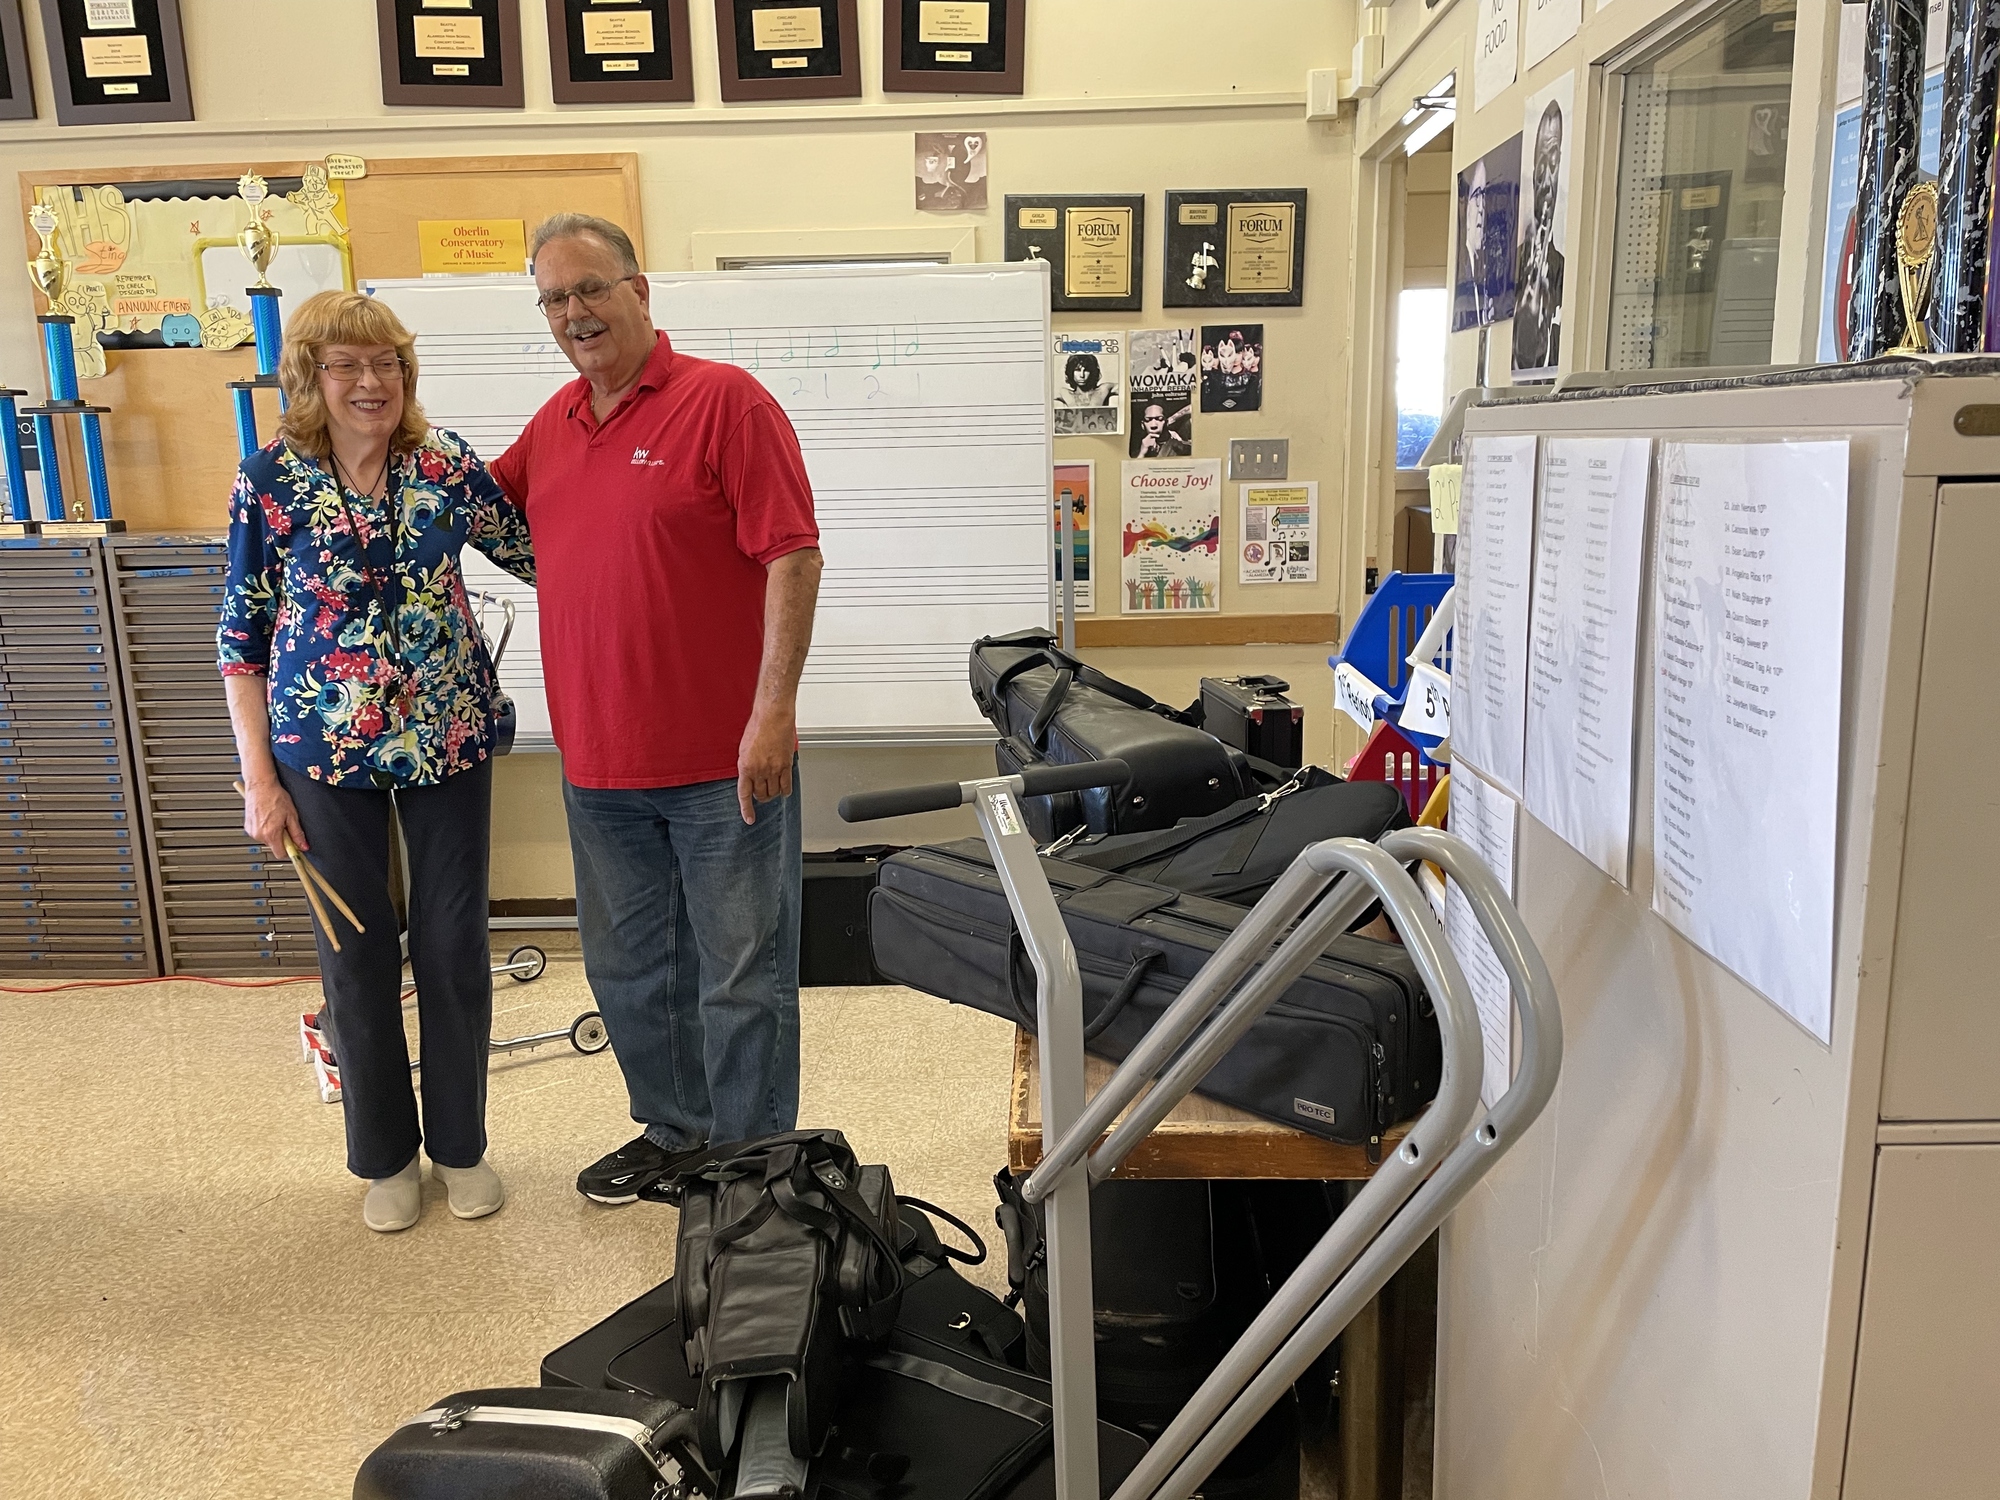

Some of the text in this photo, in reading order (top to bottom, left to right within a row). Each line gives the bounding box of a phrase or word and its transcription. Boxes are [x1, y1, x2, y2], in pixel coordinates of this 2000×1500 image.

[90, 8, 130, 16] HERITAGE
[1484, 19, 1507, 58] FOOD
[453, 226, 490, 236] Oberlin
[1077, 224, 1121, 236] FORUM
[1239, 219, 1283, 232] FORUM
[440, 238, 505, 249] Conservatory
[453, 248, 494, 259] of Music
[115, 274, 153, 282] REMEMBER
[118, 300, 191, 314] ANNOUNCEMENTS
[1130, 373, 1196, 386] WOWAKA
[788, 376, 812, 396] 2
[864, 374, 888, 400] 2
[1130, 474, 1214, 490] Choose Joy!
[1742, 592, 1764, 605] Slaughter
[1732, 654, 1754, 670] Francesca
[1426, 682, 1441, 719] 5th
[1750, 702, 1768, 718] Williams
[1297, 1102, 1331, 1119] PRO TEC
